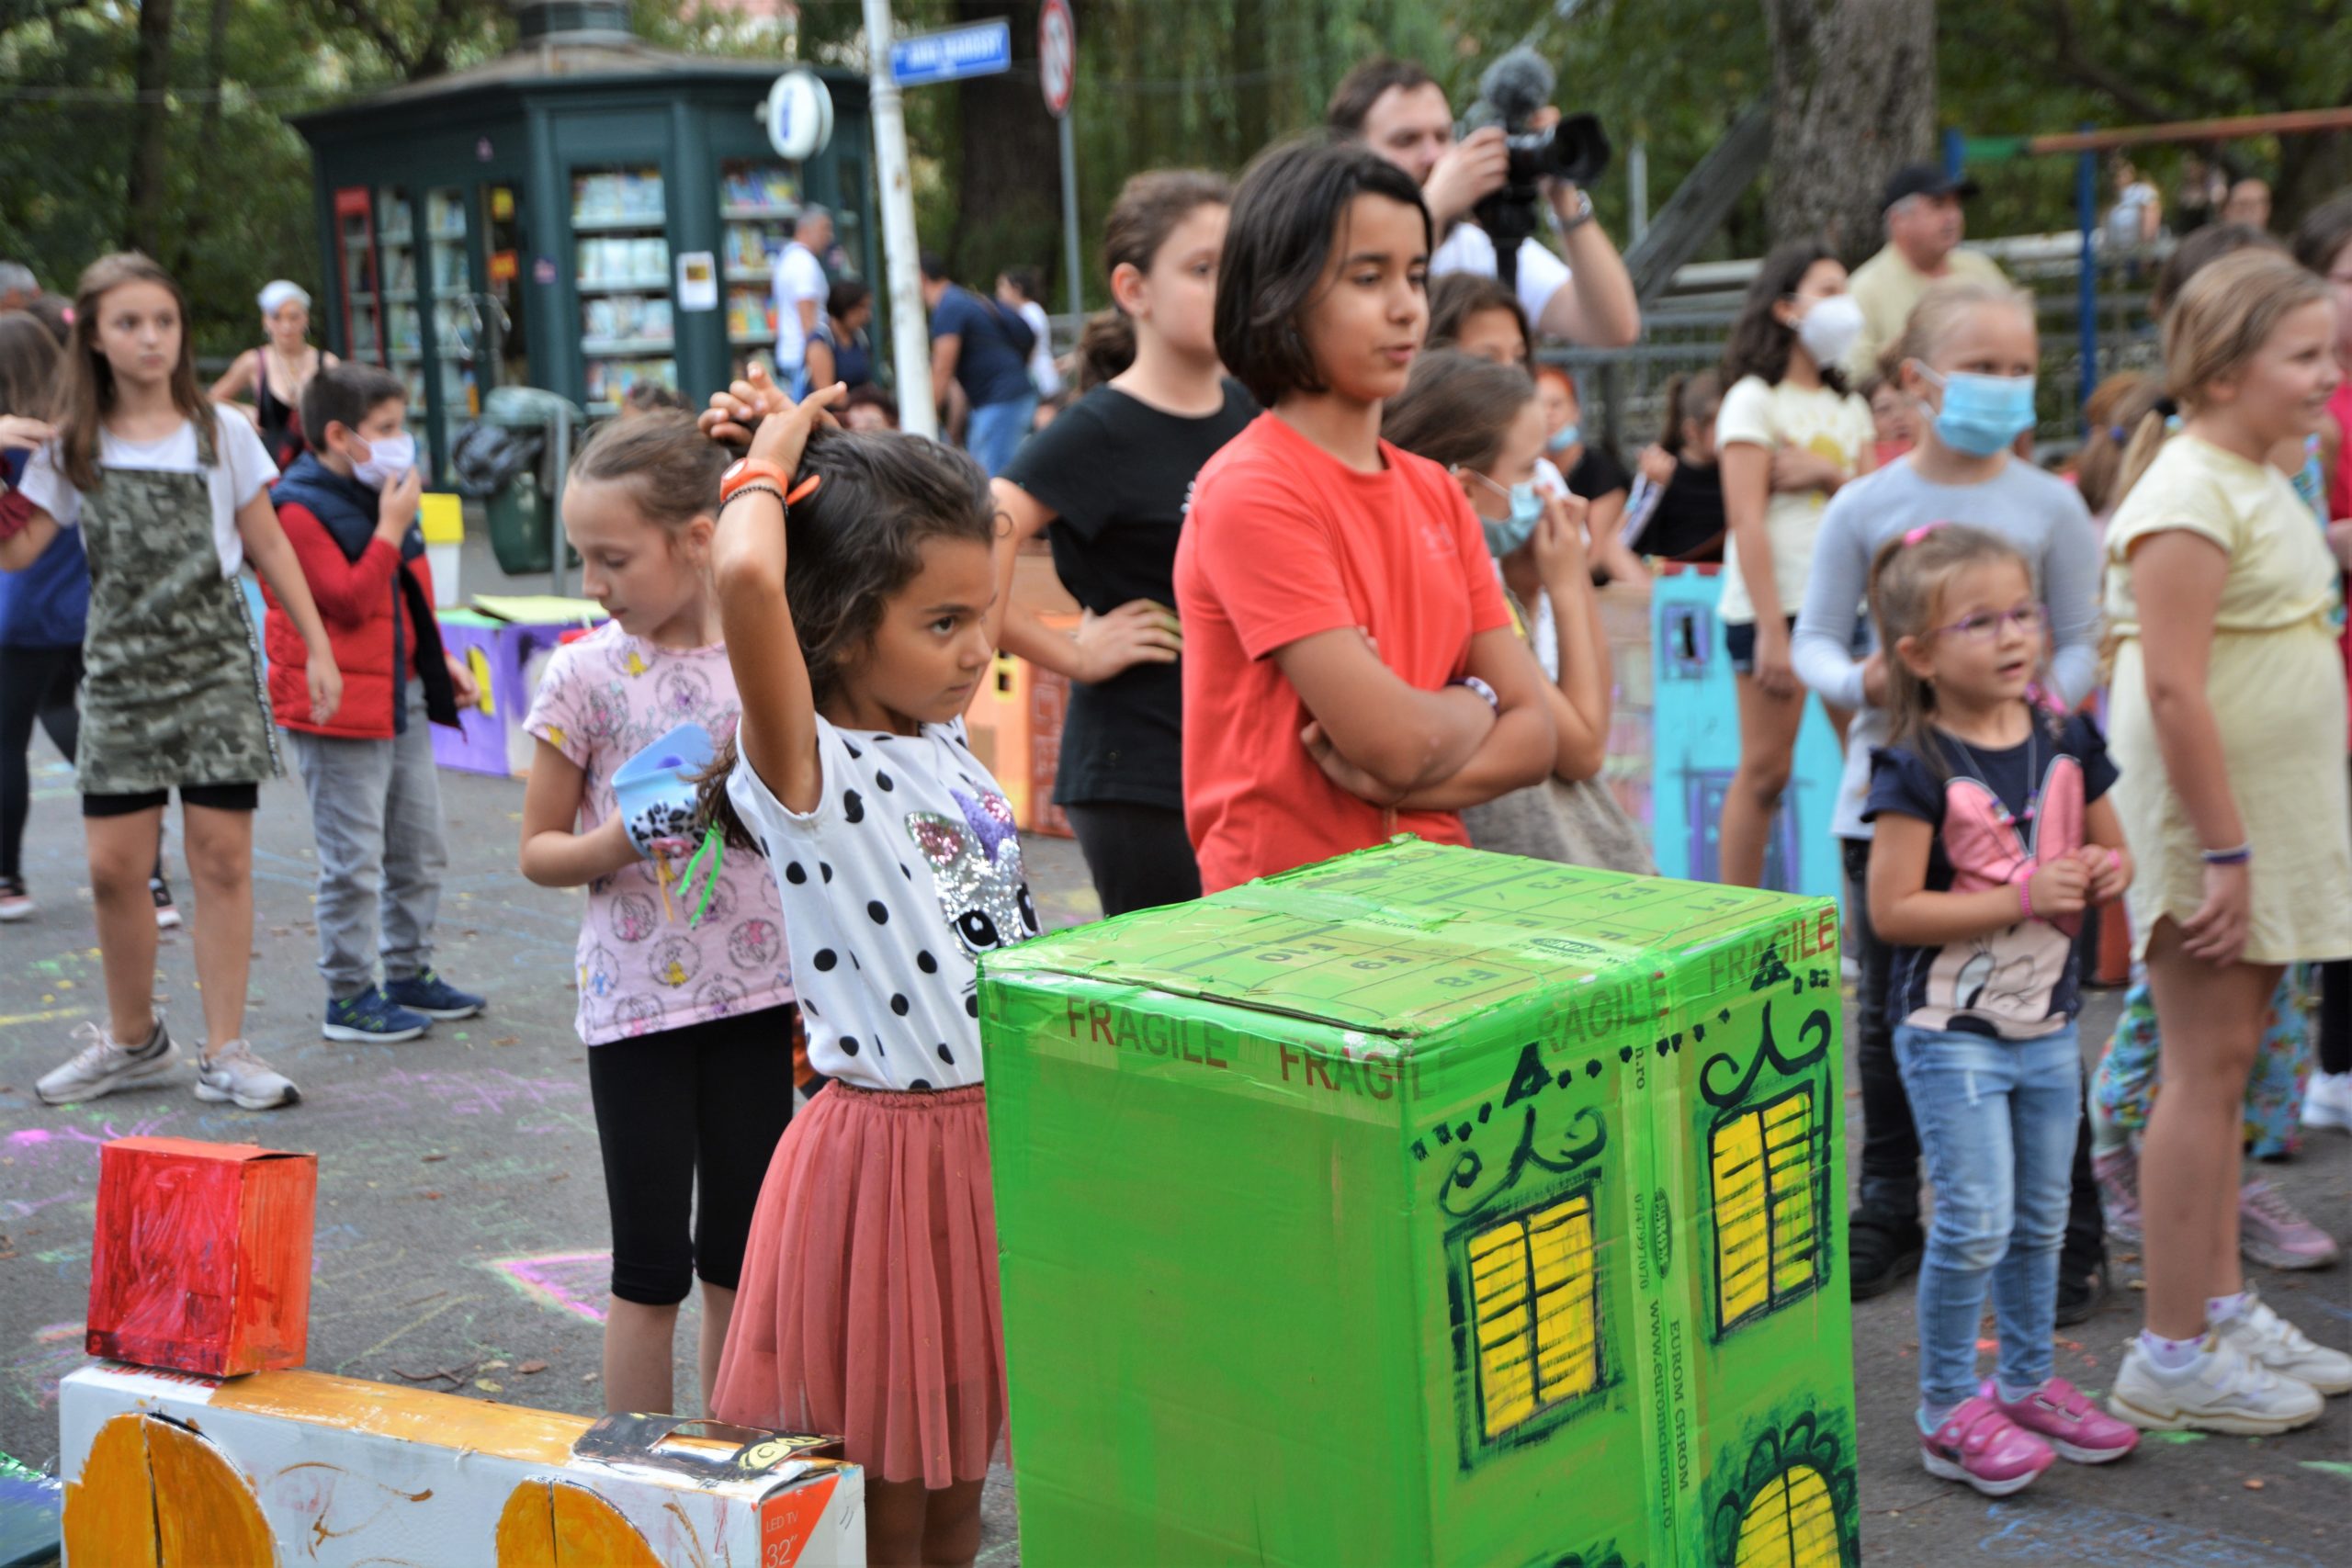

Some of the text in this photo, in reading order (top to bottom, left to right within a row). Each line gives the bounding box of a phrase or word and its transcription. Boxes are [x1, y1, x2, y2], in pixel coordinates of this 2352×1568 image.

[1434, 969, 1501, 987] F8
[1536, 970, 1670, 1054] RAGILE
[1067, 994, 1227, 1068] FRAGILE
[1650, 1298, 1673, 1529] www.euromchrom.ro
[1669, 1319, 1690, 1492] EUROM CHROM
[766, 1509, 799, 1533] LED TV
